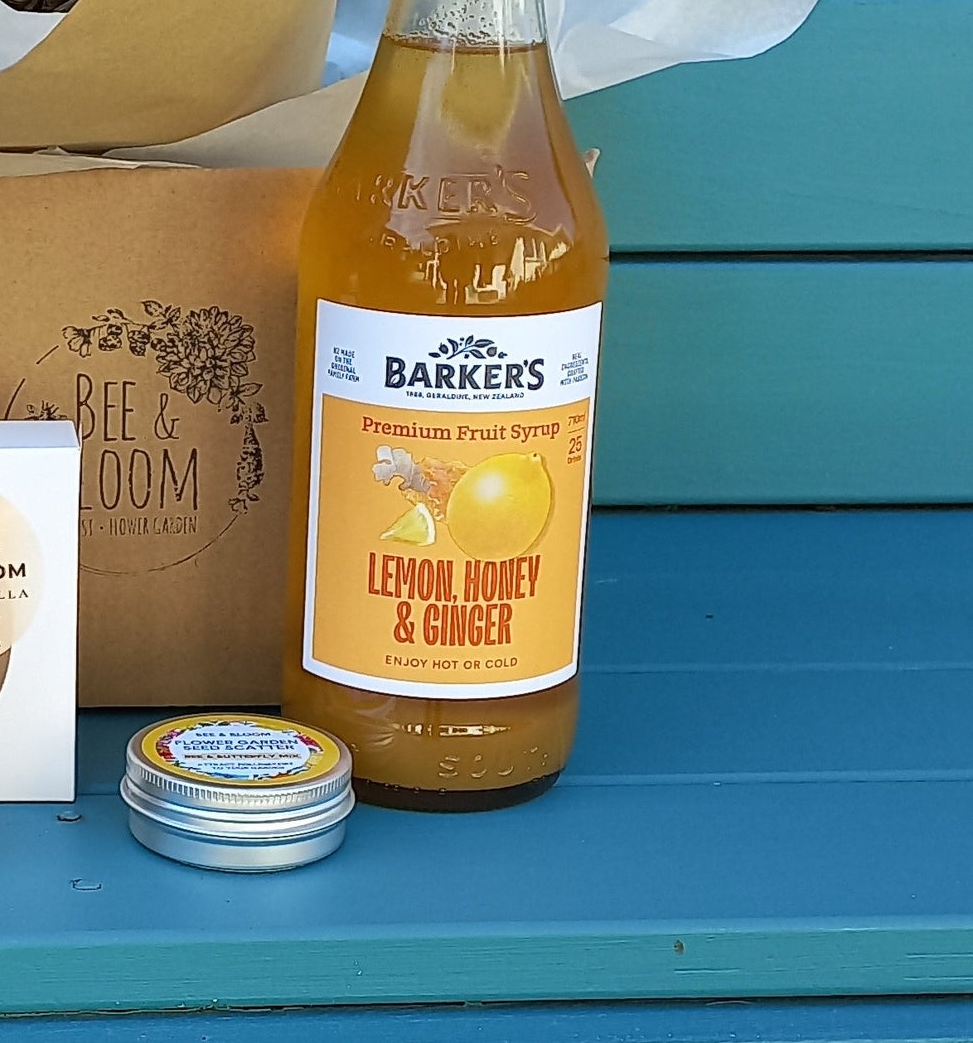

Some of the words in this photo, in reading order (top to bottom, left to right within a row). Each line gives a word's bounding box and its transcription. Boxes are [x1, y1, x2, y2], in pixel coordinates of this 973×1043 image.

[384, 356, 545, 391] BARKER'S
[76, 373, 136, 442] BEE
[153, 393, 180, 440] &
[472, 393, 490, 401] NEW
[492, 391, 525, 400] ZEALAND
[361, 416, 452, 441] Premium
[456, 424, 507, 441] Fruit
[510, 421, 561, 444] Syrup
[568, 435, 583, 455] 25
[153, 515, 198, 536] GARDEN
[368, 551, 458, 604] LEMON,
[464, 554, 541, 603] HONEY
[393, 600, 416, 644] &
[422, 602, 513, 647] GINGER
[385, 654, 428, 669] ENJOY
[432, 659, 459, 670] HOT
[463, 659, 481, 670] OR
[485, 657, 518, 669] COLD
